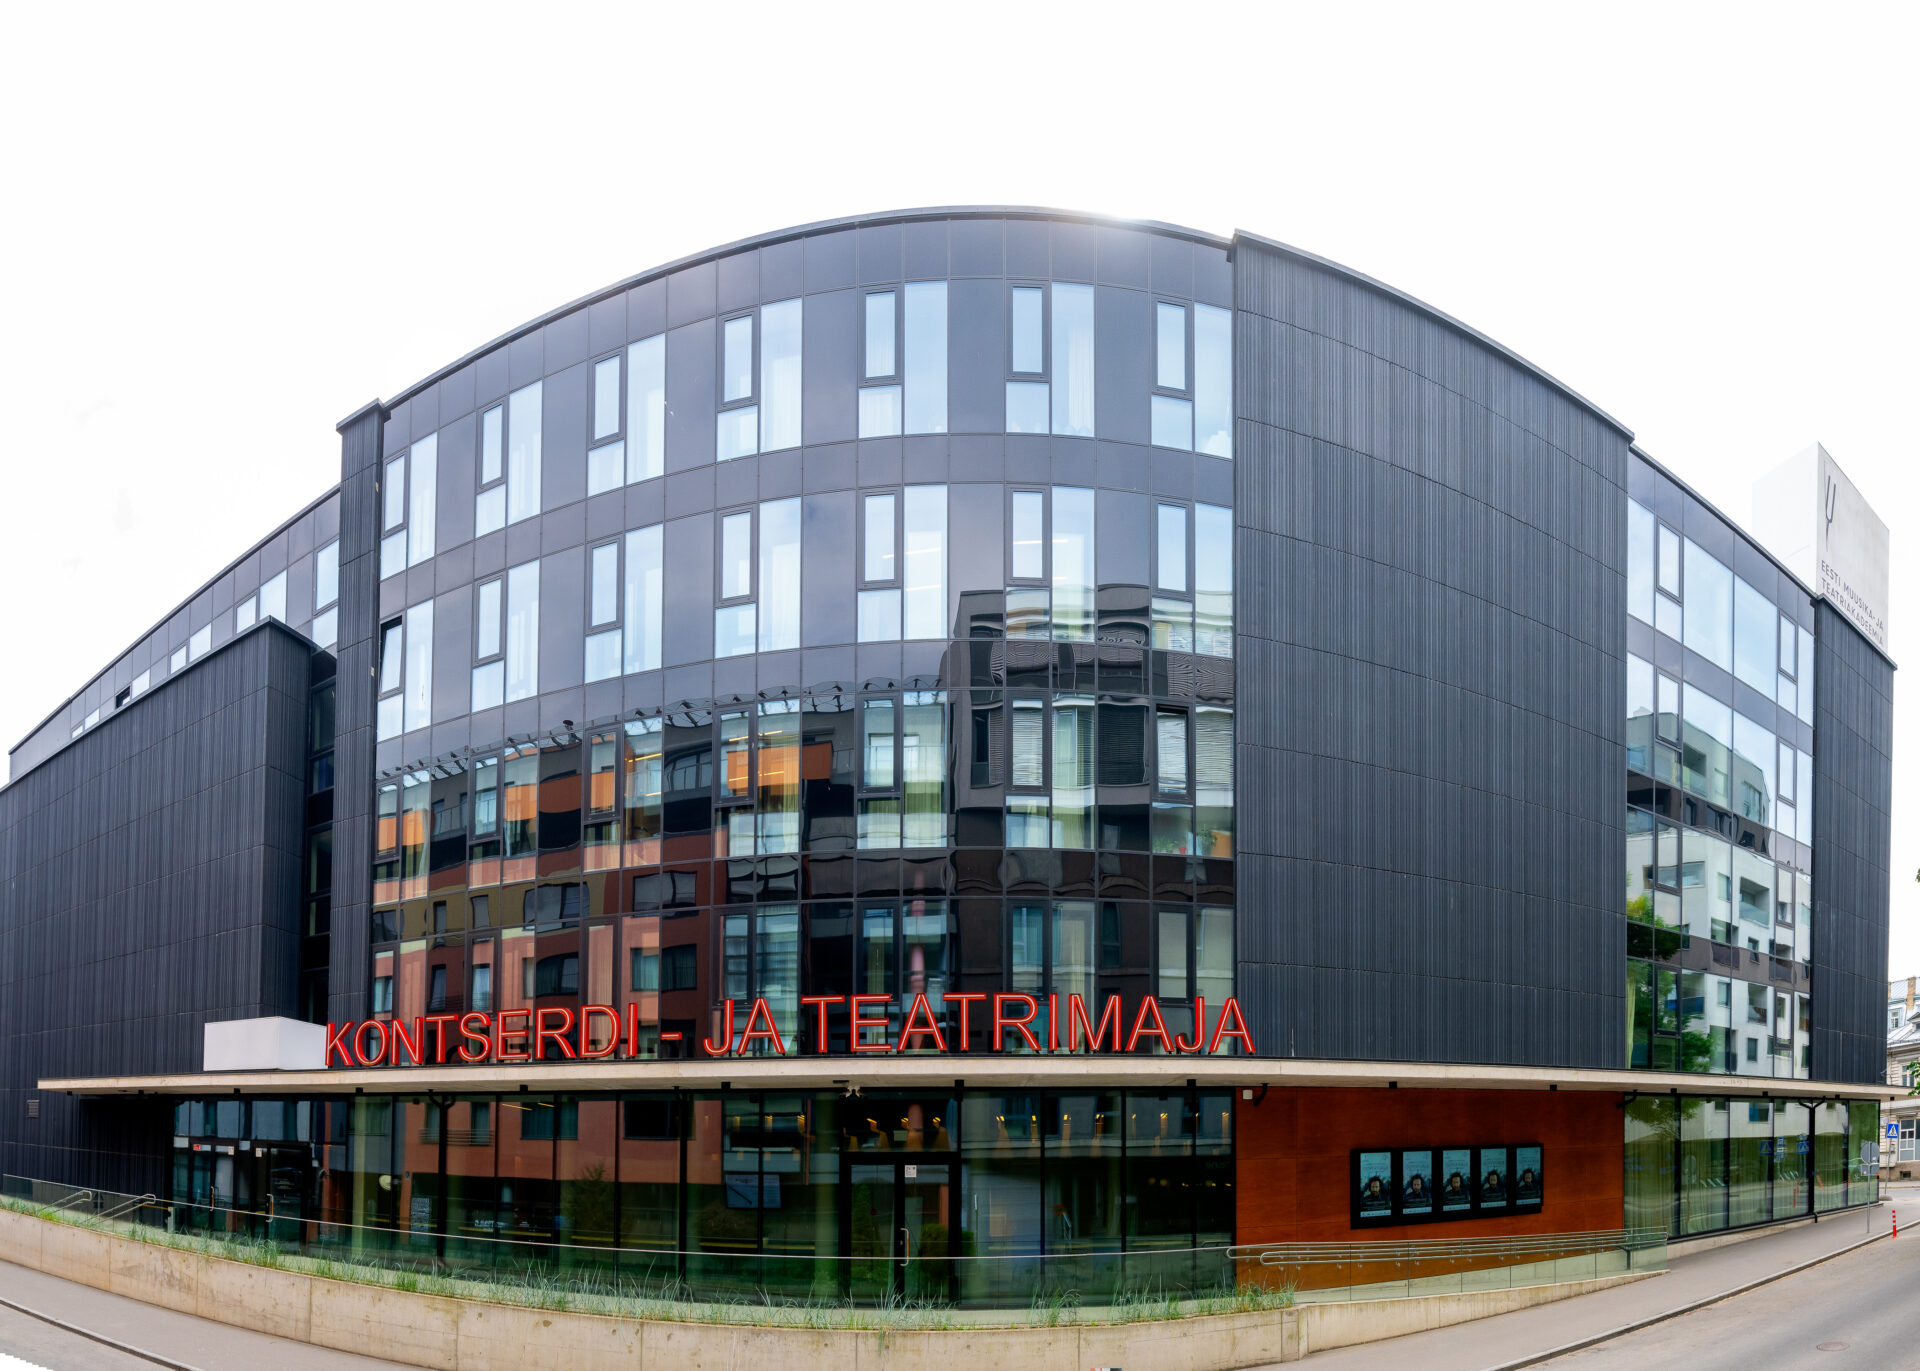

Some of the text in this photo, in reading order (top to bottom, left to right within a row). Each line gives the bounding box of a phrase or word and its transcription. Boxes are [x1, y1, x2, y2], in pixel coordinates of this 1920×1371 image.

[1821, 559, 1841, 587] EESTI
[1875, 617, 1884, 632] JA
[1821, 577, 1884, 646] TEATRIAKADEEMIA
[703, 997, 786, 1056] JA
[801, 992, 1256, 1054] TEATRIMAJA
